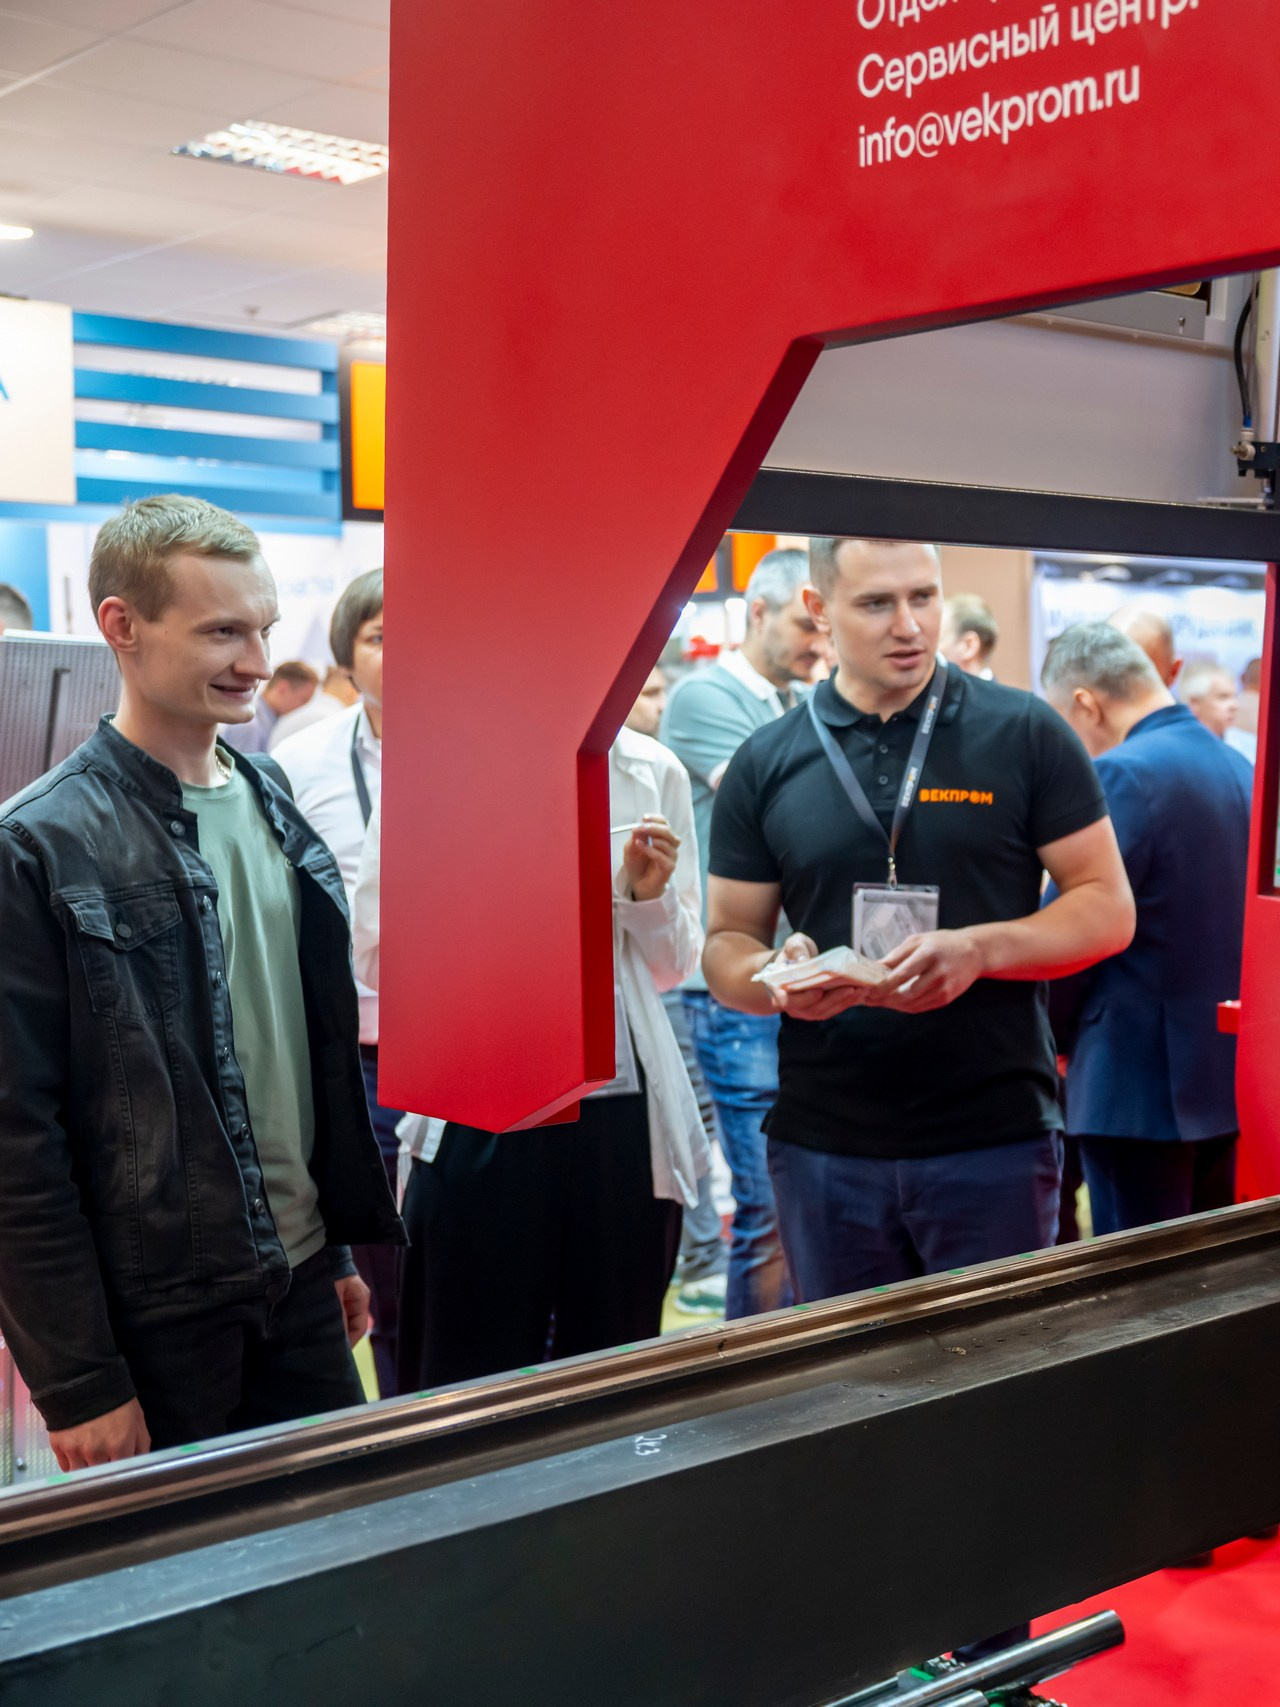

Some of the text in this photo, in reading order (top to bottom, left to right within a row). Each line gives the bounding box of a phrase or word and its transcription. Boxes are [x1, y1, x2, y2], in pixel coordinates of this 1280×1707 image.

[858, 4, 1060, 98] Сервисный
[858, 66, 1140, 167] info@vekprom.ru
[919, 789, 993, 804] ВЕКПРОМ
